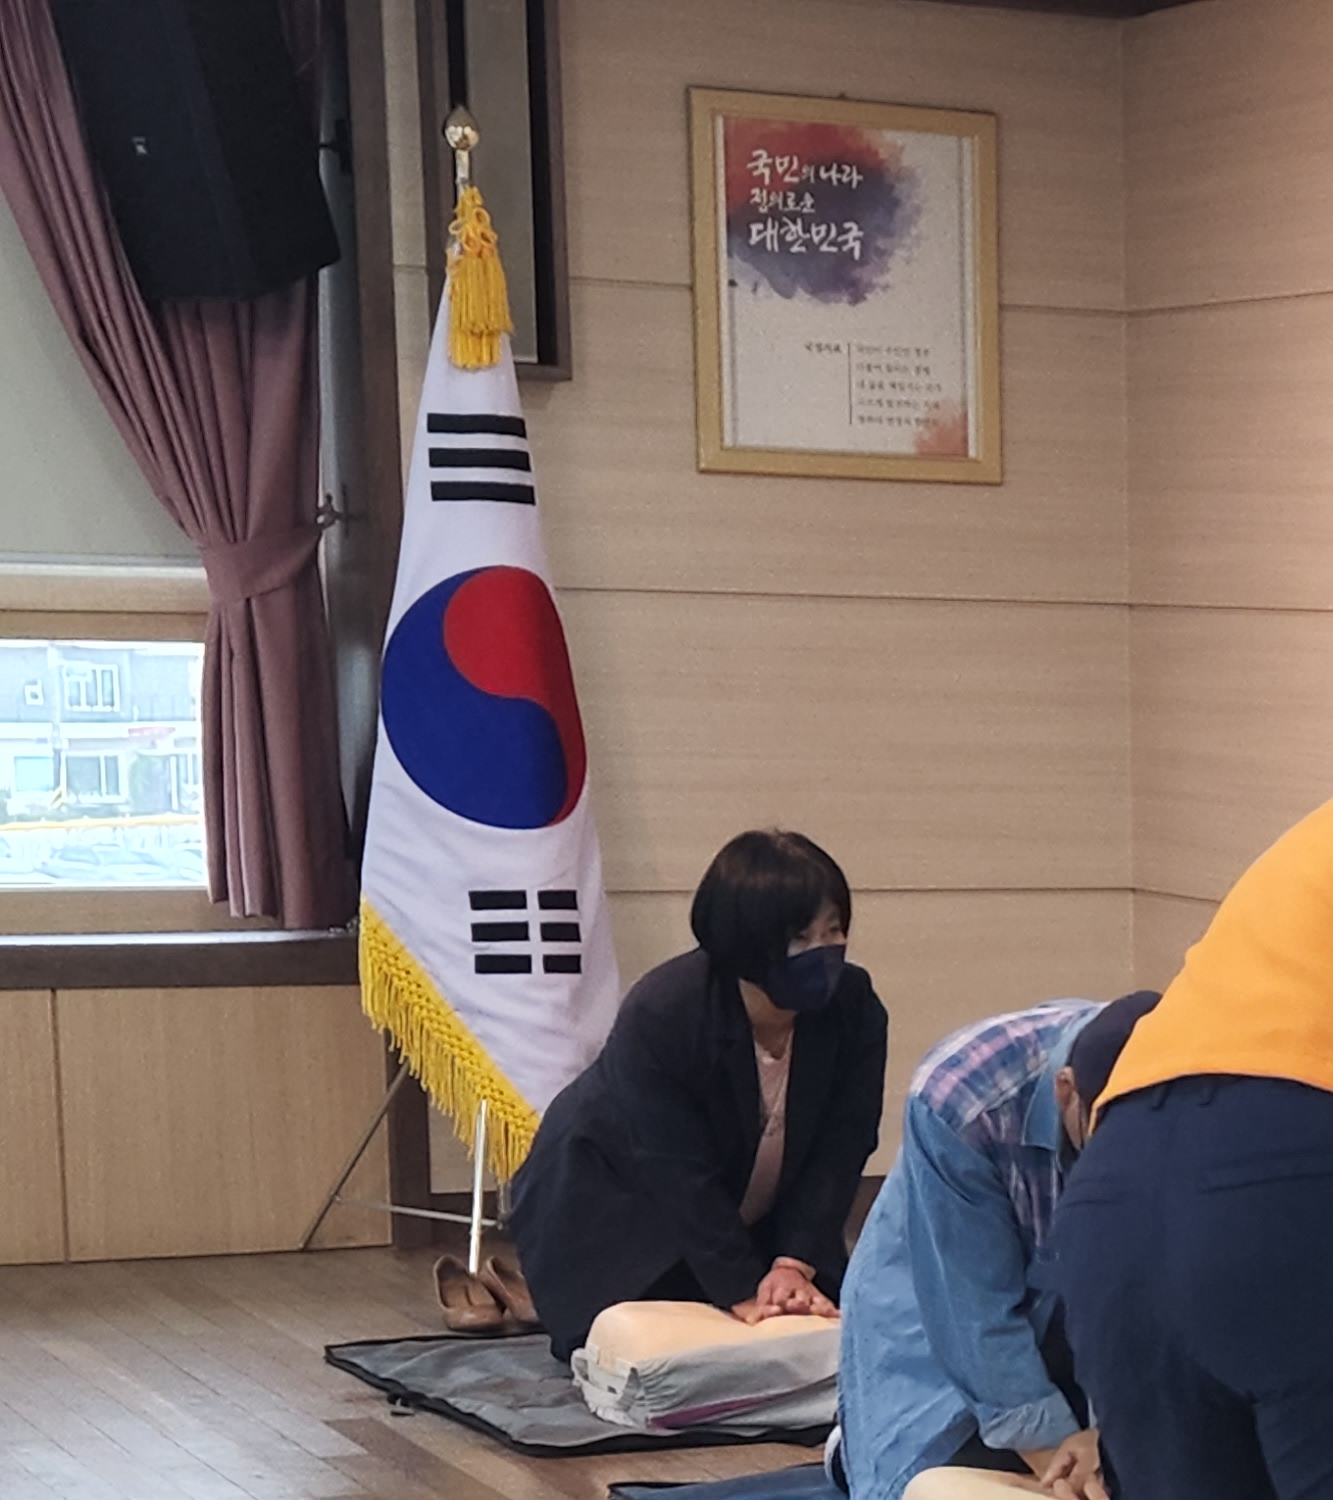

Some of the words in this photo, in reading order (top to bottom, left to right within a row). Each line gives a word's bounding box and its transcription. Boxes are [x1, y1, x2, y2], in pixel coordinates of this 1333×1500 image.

[747, 149, 816, 187] 국민의
[819, 162, 864, 190] 나라
[748, 215, 865, 261] 대한민국
